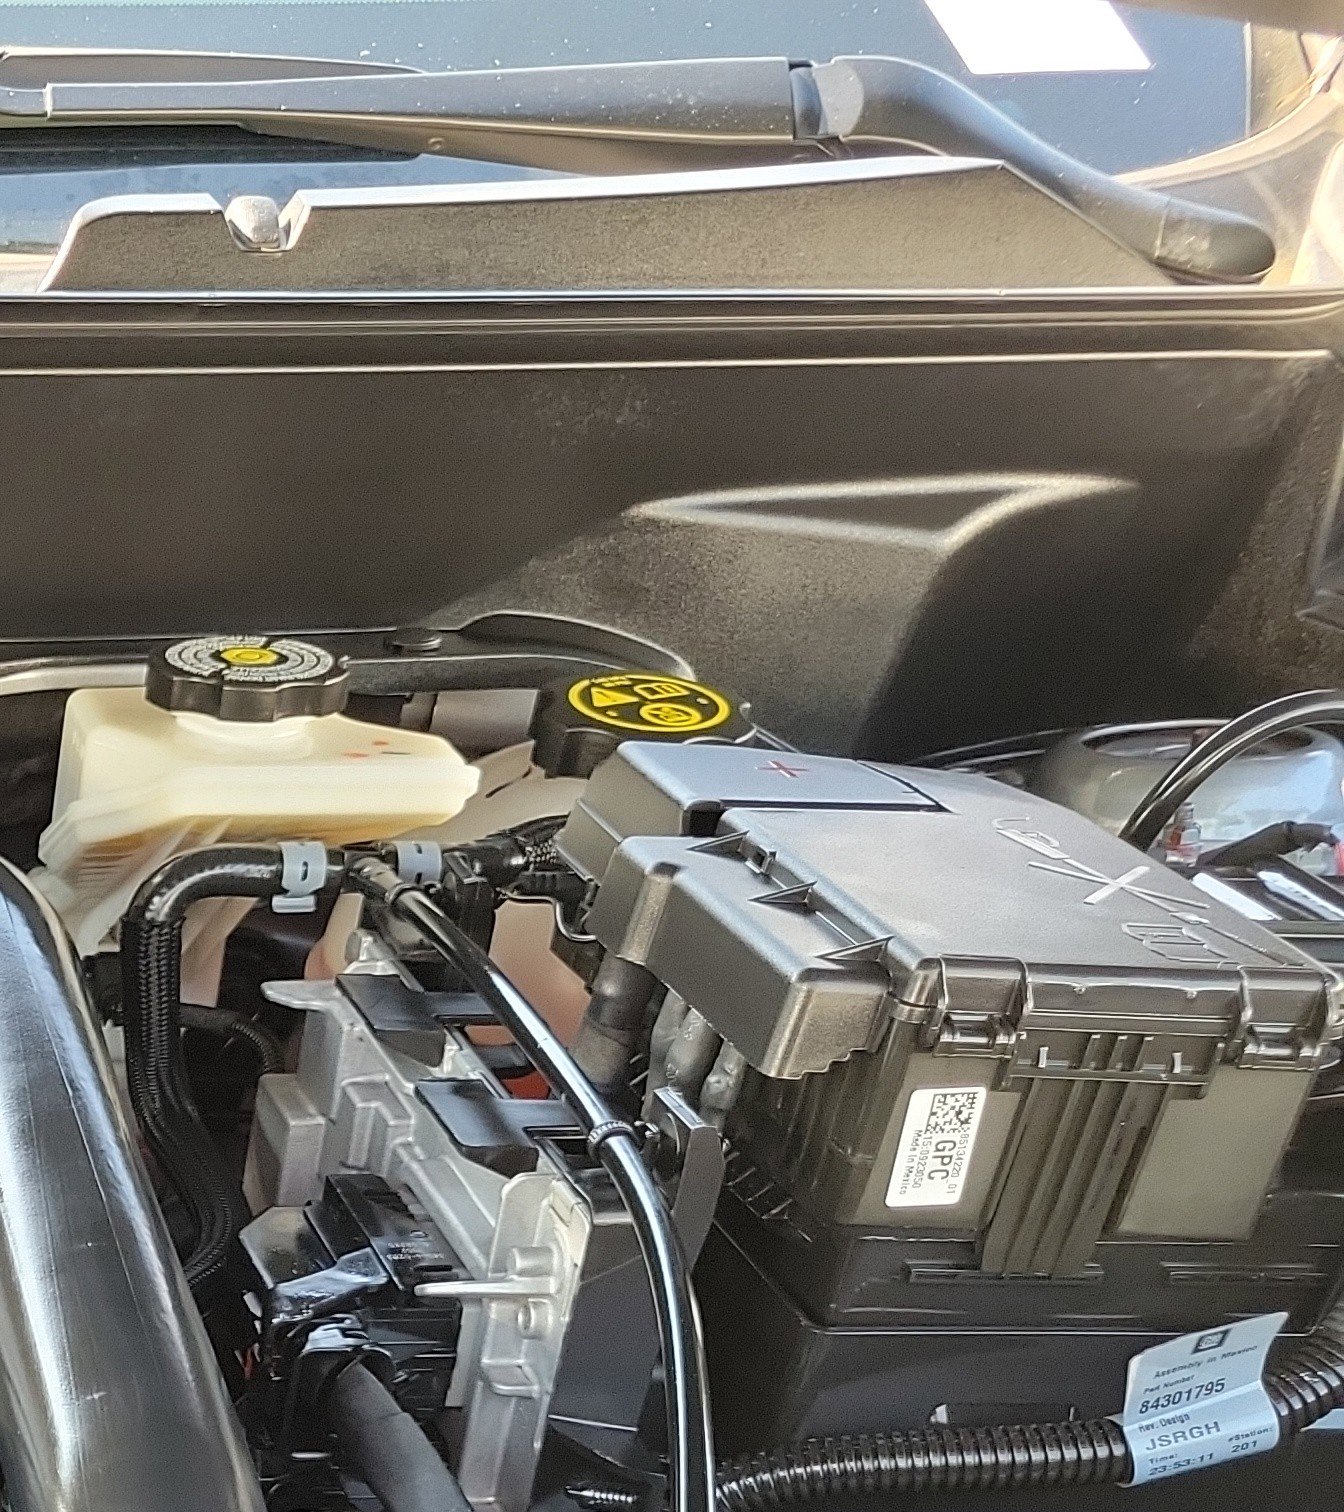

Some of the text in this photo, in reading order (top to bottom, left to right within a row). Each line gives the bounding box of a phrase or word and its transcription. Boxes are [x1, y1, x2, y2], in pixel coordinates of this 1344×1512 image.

[927, 1139, 957, 1181] GPC
[1154, 1360, 1203, 1379] Assembly
[1143, 1374, 1195, 1395] Part Number
[1139, 1377, 1226, 1415] 84301795
[1161, 1411, 1191, 1427] Design
[1146, 1420, 1221, 1452] JSRGH
[1231, 1440, 1258, 1454] 201
